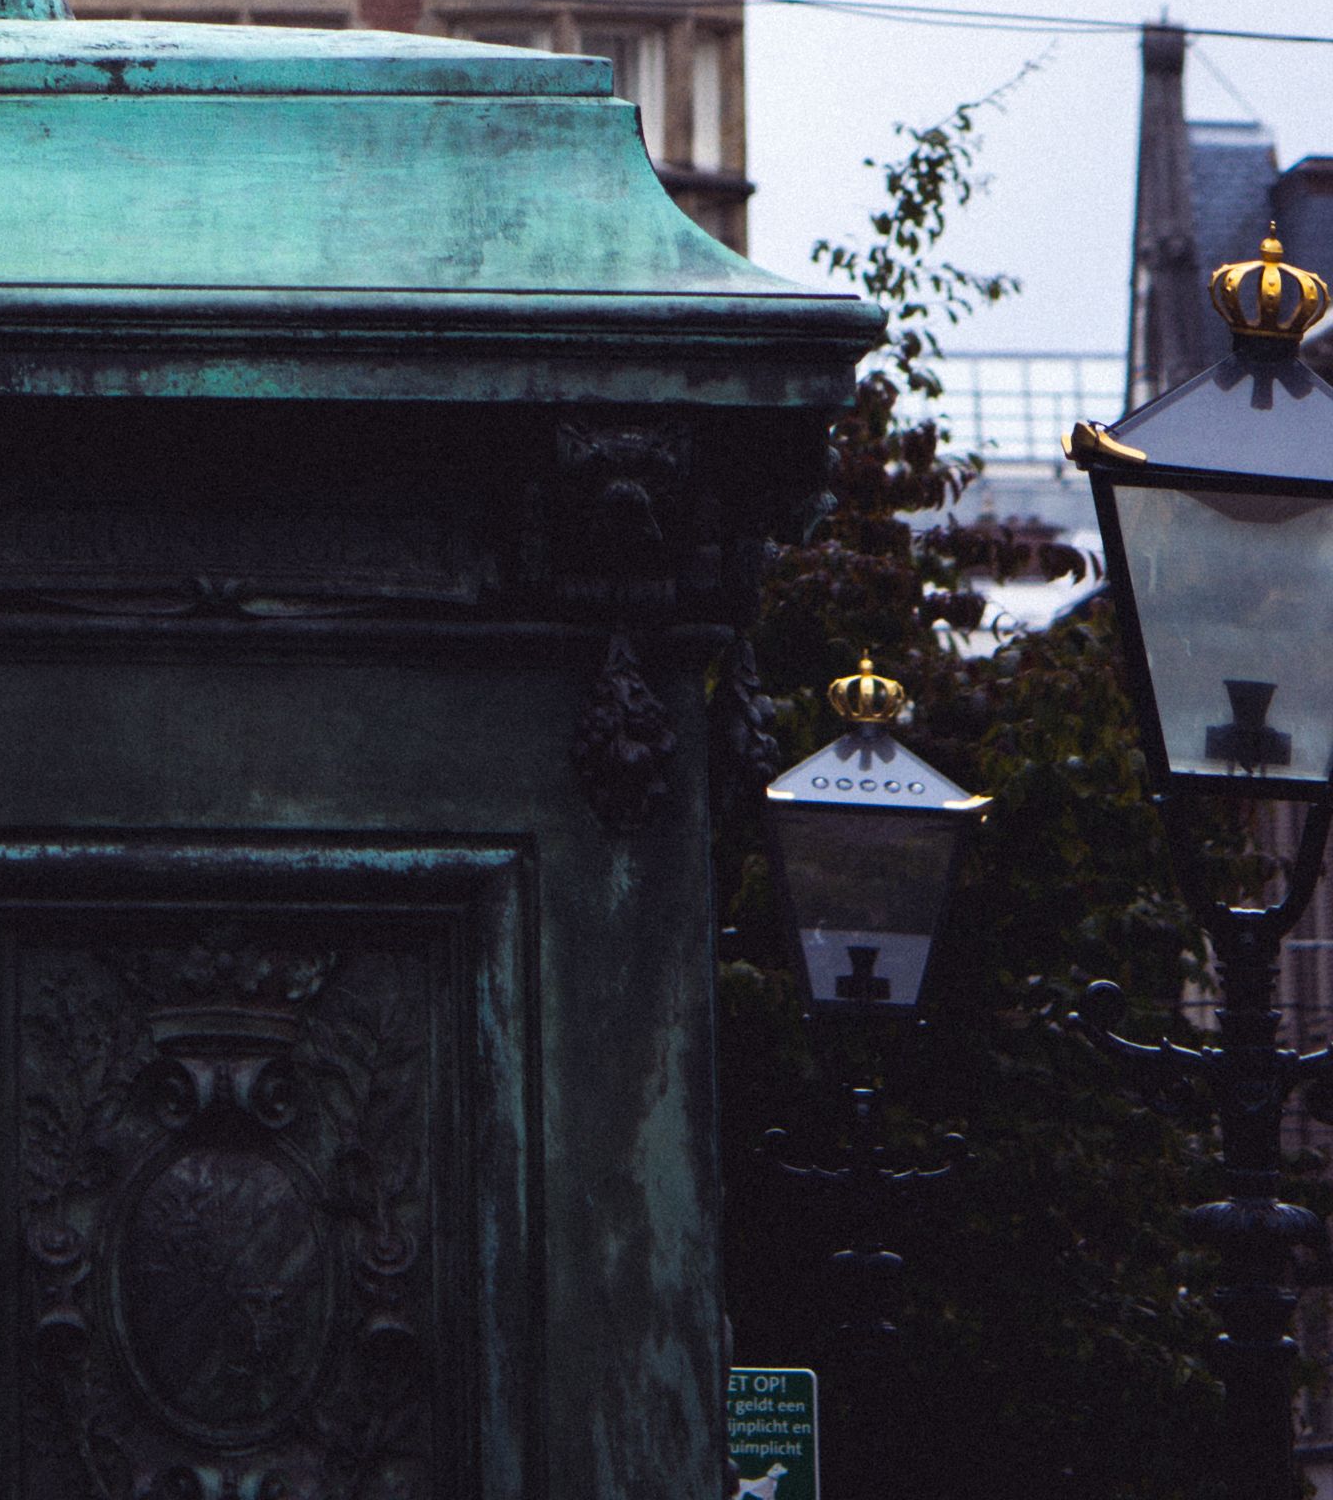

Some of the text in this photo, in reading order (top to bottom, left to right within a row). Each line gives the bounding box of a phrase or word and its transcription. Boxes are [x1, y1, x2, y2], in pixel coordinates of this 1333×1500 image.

[728, 1375, 786, 1393] ET OP!
[736, 1397, 774, 1415] geldt
[778, 1402, 805, 1412] een
[728, 1419, 811, 1436] ijnplicht en
